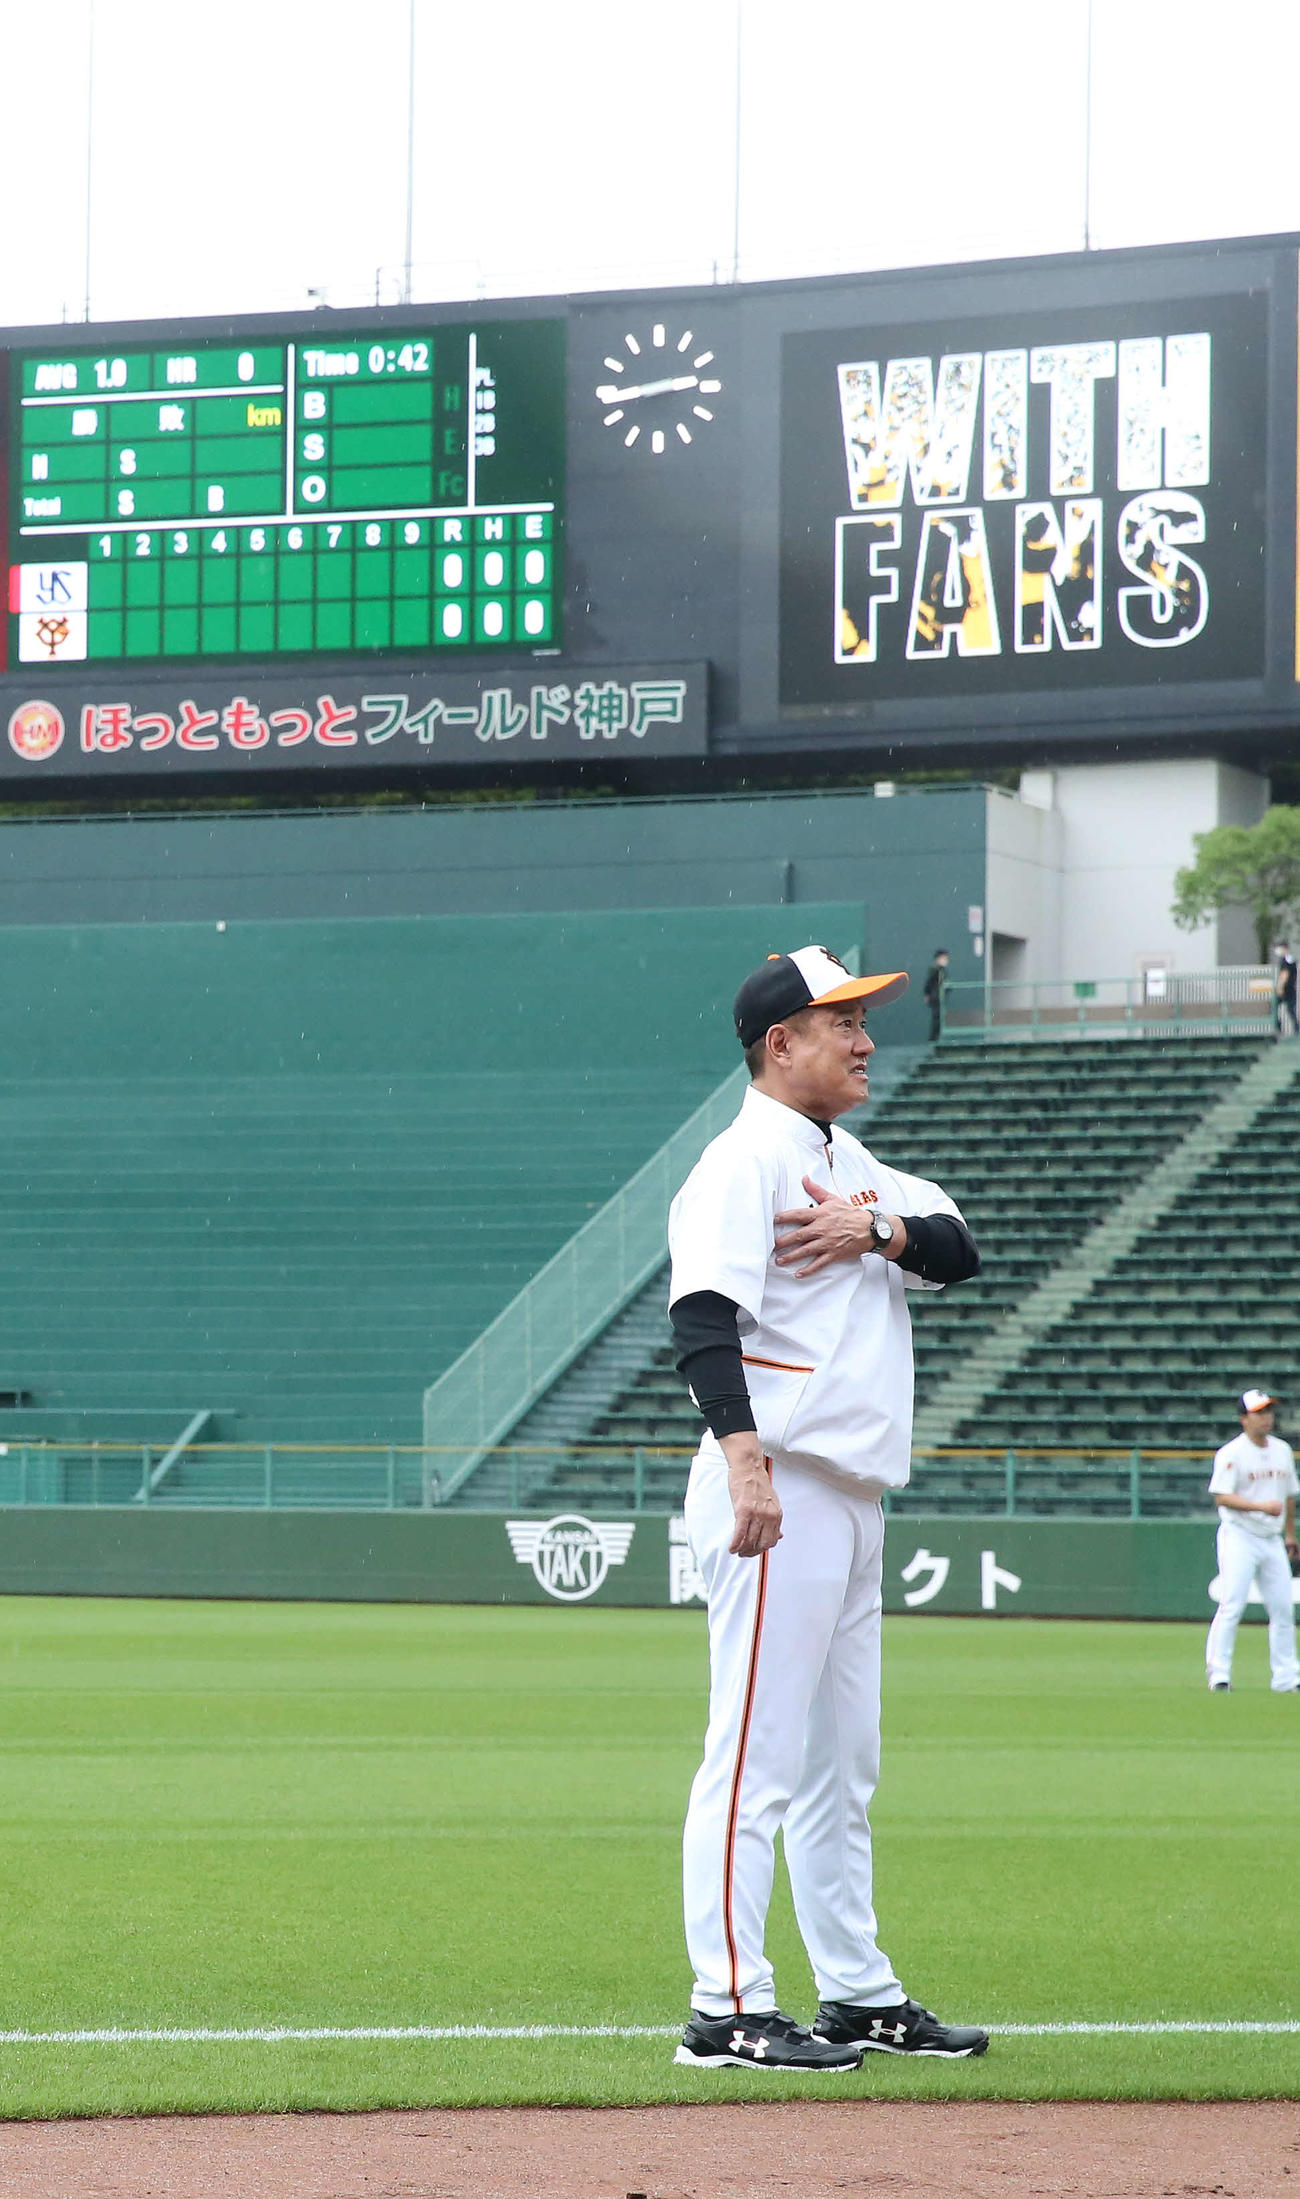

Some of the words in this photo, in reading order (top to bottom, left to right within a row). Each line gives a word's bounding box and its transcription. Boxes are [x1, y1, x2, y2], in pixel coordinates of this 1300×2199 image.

[303, 350, 359, 377] Time
[368, 342, 429, 374] 0:42
[247, 402, 281, 427] km
[303, 391, 326, 419] B
[836, 332, 1211, 511] WITH
[119, 448, 136, 475] S
[303, 433, 325, 461] S
[117, 489, 135, 516] S
[99, 534, 112, 557] 1
[135, 533, 151, 556] 2
[173, 531, 188, 554] 3
[211, 529, 227, 553] 4
[250, 528, 266, 551] 5
[287, 526, 303, 550] 6
[326, 525, 342, 548] 7
[365, 523, 381, 546] 8
[403, 521, 420, 545] 9
[443, 518, 462, 542] R
[484, 516, 503, 540] H
[525, 514, 543, 539] E
[834, 490, 1209, 664] FANS
[81, 680, 687, 753] ほっともっとフィールド神戸
